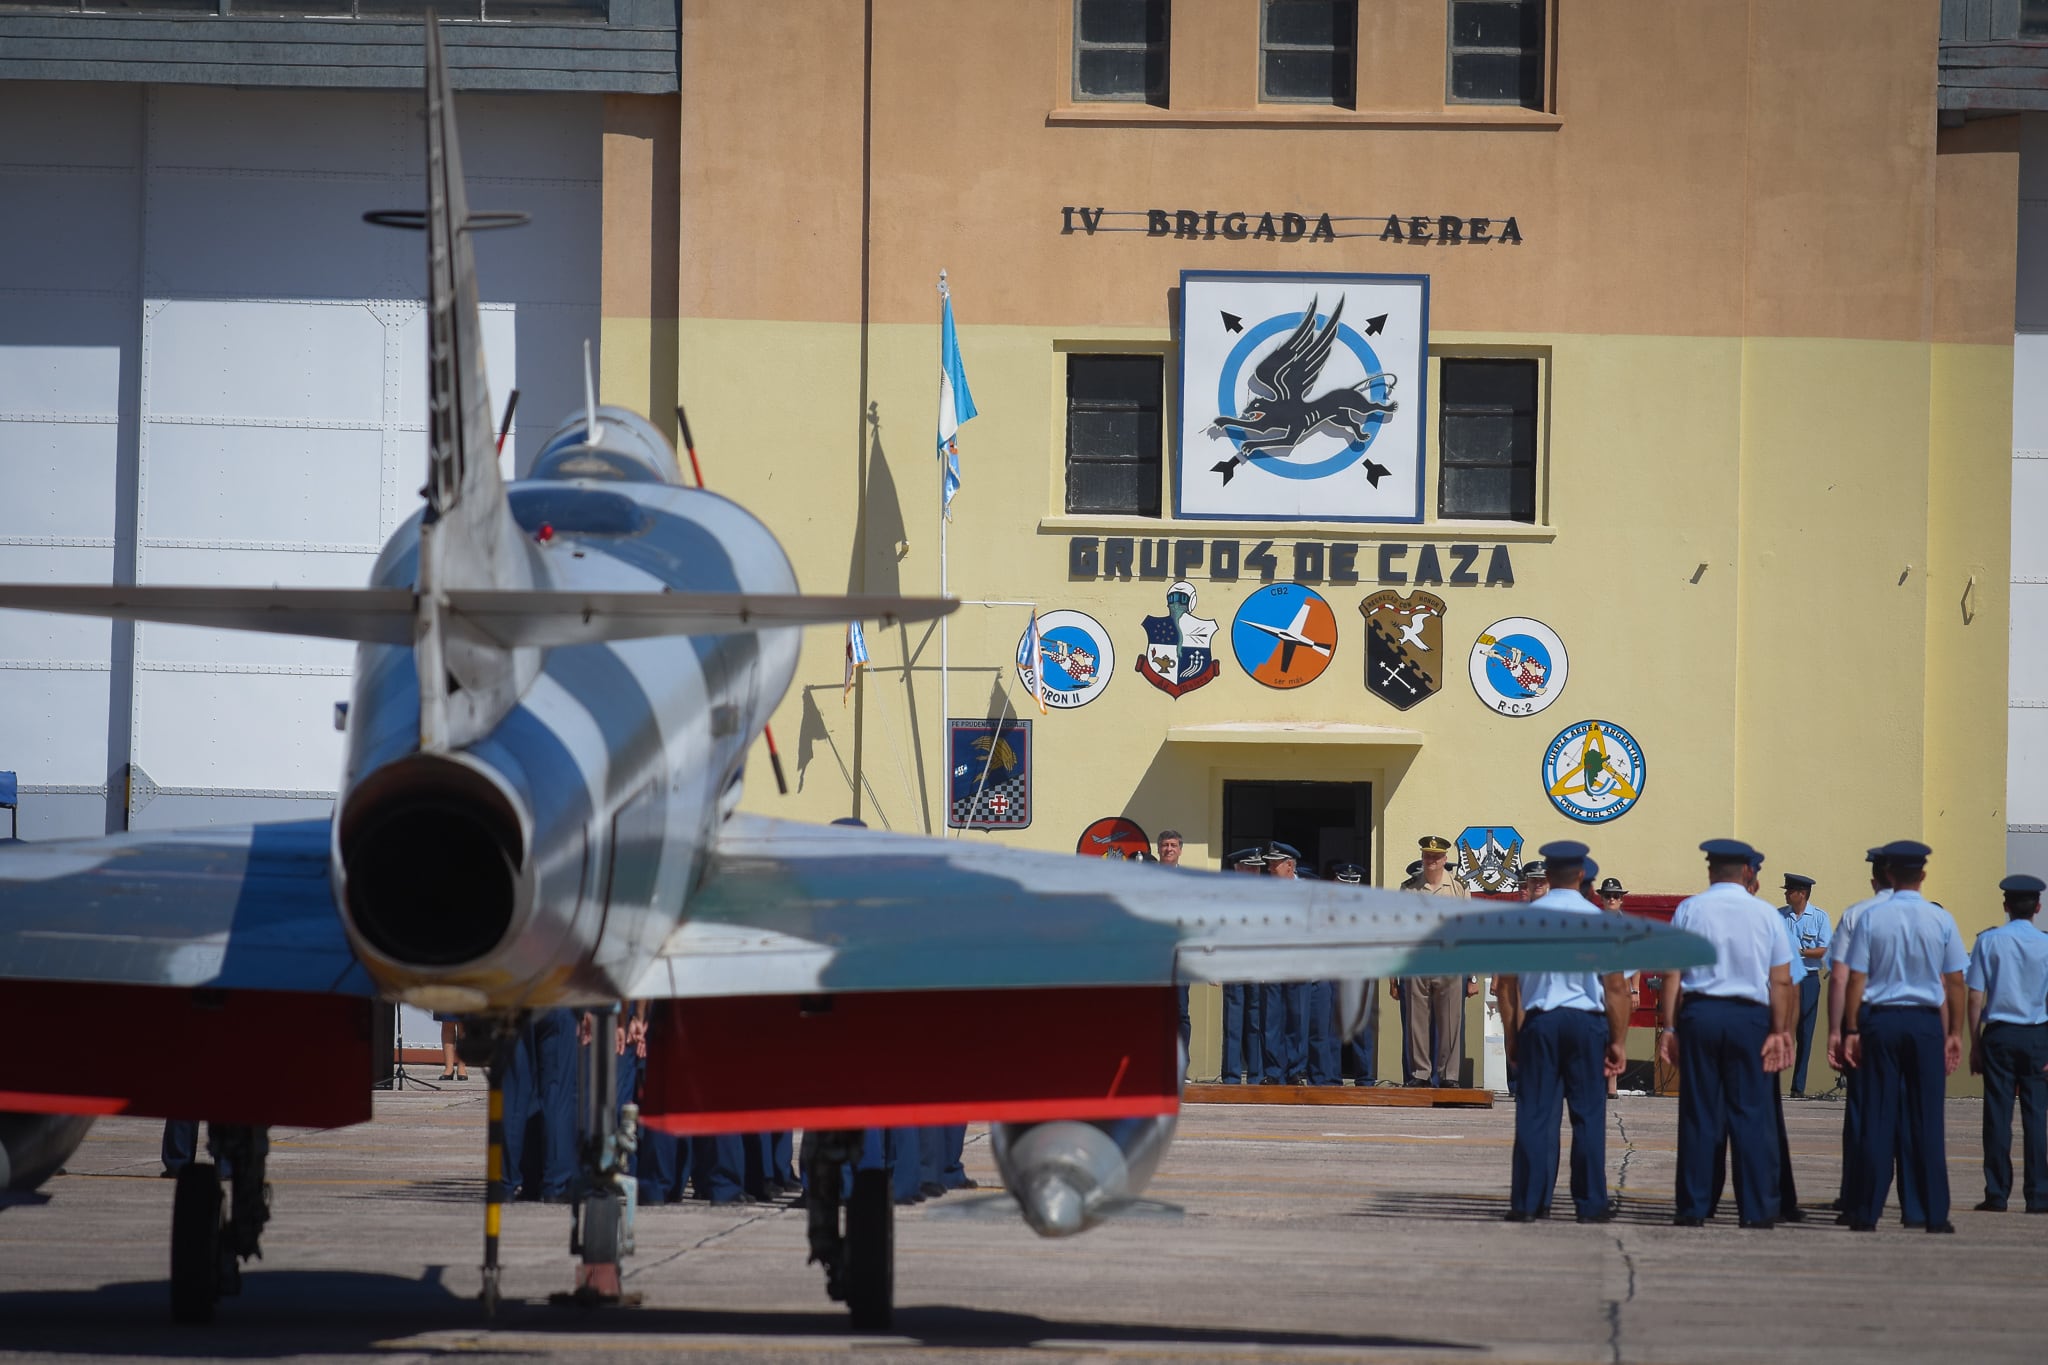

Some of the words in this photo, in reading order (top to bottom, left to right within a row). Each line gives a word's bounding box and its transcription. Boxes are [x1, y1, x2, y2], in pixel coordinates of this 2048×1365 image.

[1061, 206, 1104, 235] IV
[1146, 209, 1335, 243] BRIGADA
[1380, 213, 1523, 246] AEREA
[1293, 542, 1359, 586] DE
[1377, 543, 1515, 586] CAZA
[1270, 586, 1289, 597] CB2
[1548, 736, 1569, 766] FUERZA
[1571, 724, 1599, 737] AEREA
[1603, 725, 1641, 769] ARGENTINA
[1560, 798, 1583, 816] CRUZ
[1586, 810, 1604, 818] DEL
[1606, 801, 1626, 816] SUR
